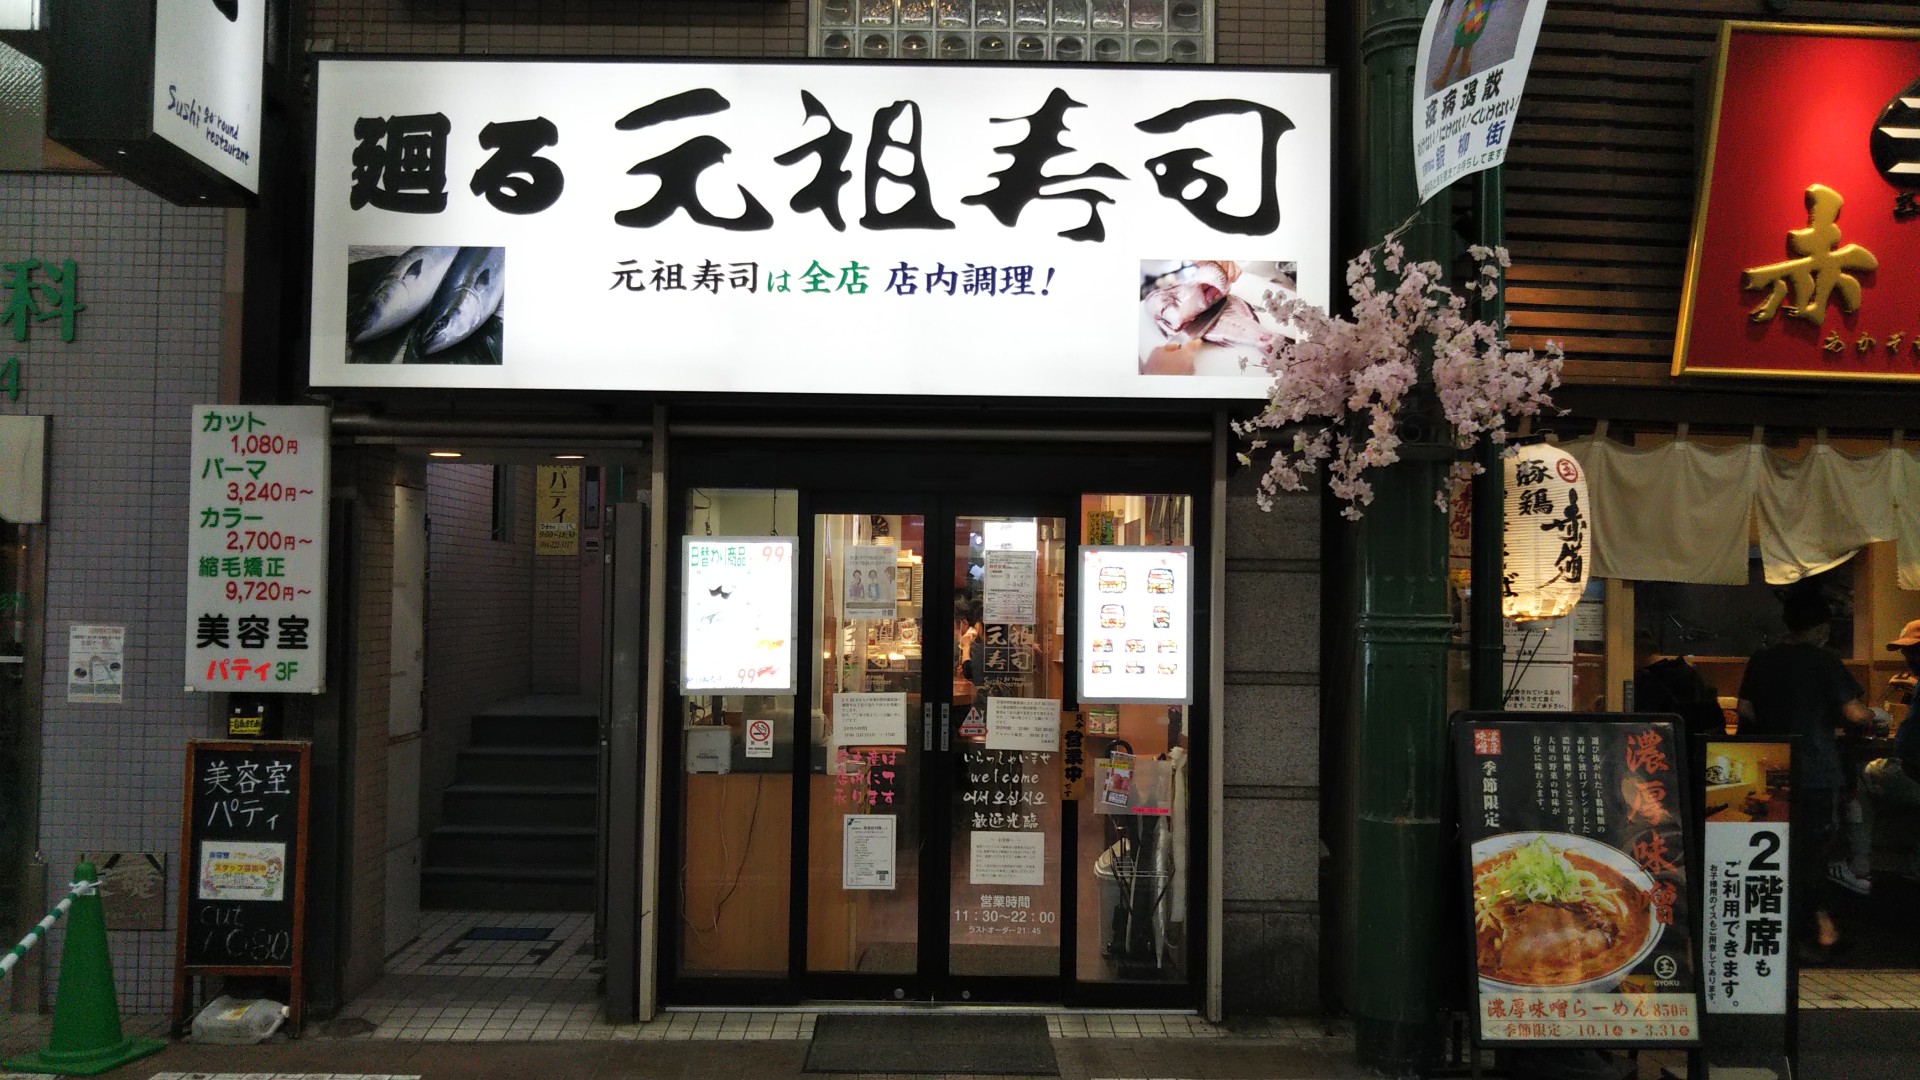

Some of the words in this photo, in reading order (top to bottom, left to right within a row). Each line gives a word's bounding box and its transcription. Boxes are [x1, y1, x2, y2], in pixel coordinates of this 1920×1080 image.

[168, 85, 202, 129] Sushi
[206, 127, 250, 165] restaurant
[349, 110, 565, 216] 廻る
[614, 87, 1296, 243] 元祖寿司
[1741, 184, 1879, 326] 赤
[608, 258, 870, 296] 元祖寿司は全店
[883, 259, 1056, 297] 店内調理!
[1, 257, 85, 342] 科
[202, 410, 267, 433] カット
[230, 434, 298, 456] 1,080円
[201, 457, 267, 480] パーマ
[548, 471, 568, 524] パティ
[199, 507, 263, 529] カラー
[198, 557, 285, 578] 縮毛矯正
[196, 612, 310, 650] 美容室
[206, 658, 271, 681] パティ
[275, 661, 298, 681] 3F
[985, 648, 1032, 671] 寿司
[963, 751, 1051, 765] いらっしゃいませ
[1064, 730, 1084, 783] 営業中
[203, 760, 293, 796] 美容室
[970, 768, 1040, 784] welcome
[1481, 760, 1500, 828] 季節限定
[207, 799, 279, 830] パティ
[963, 790, 989, 803] 어서
[992, 791, 1048, 806] 오십시오
[1626, 729, 1679, 925] 濃厚味噌
[980, 894, 1031, 909] 営業時間
[1743, 830, 1784, 978] 2階席も
[1722, 860, 1741, 1007] ご利用できます。
[1487, 999, 1648, 1018] 濃厚味噌らーめん
[1652, 1003, 1688, 1017] 850円
